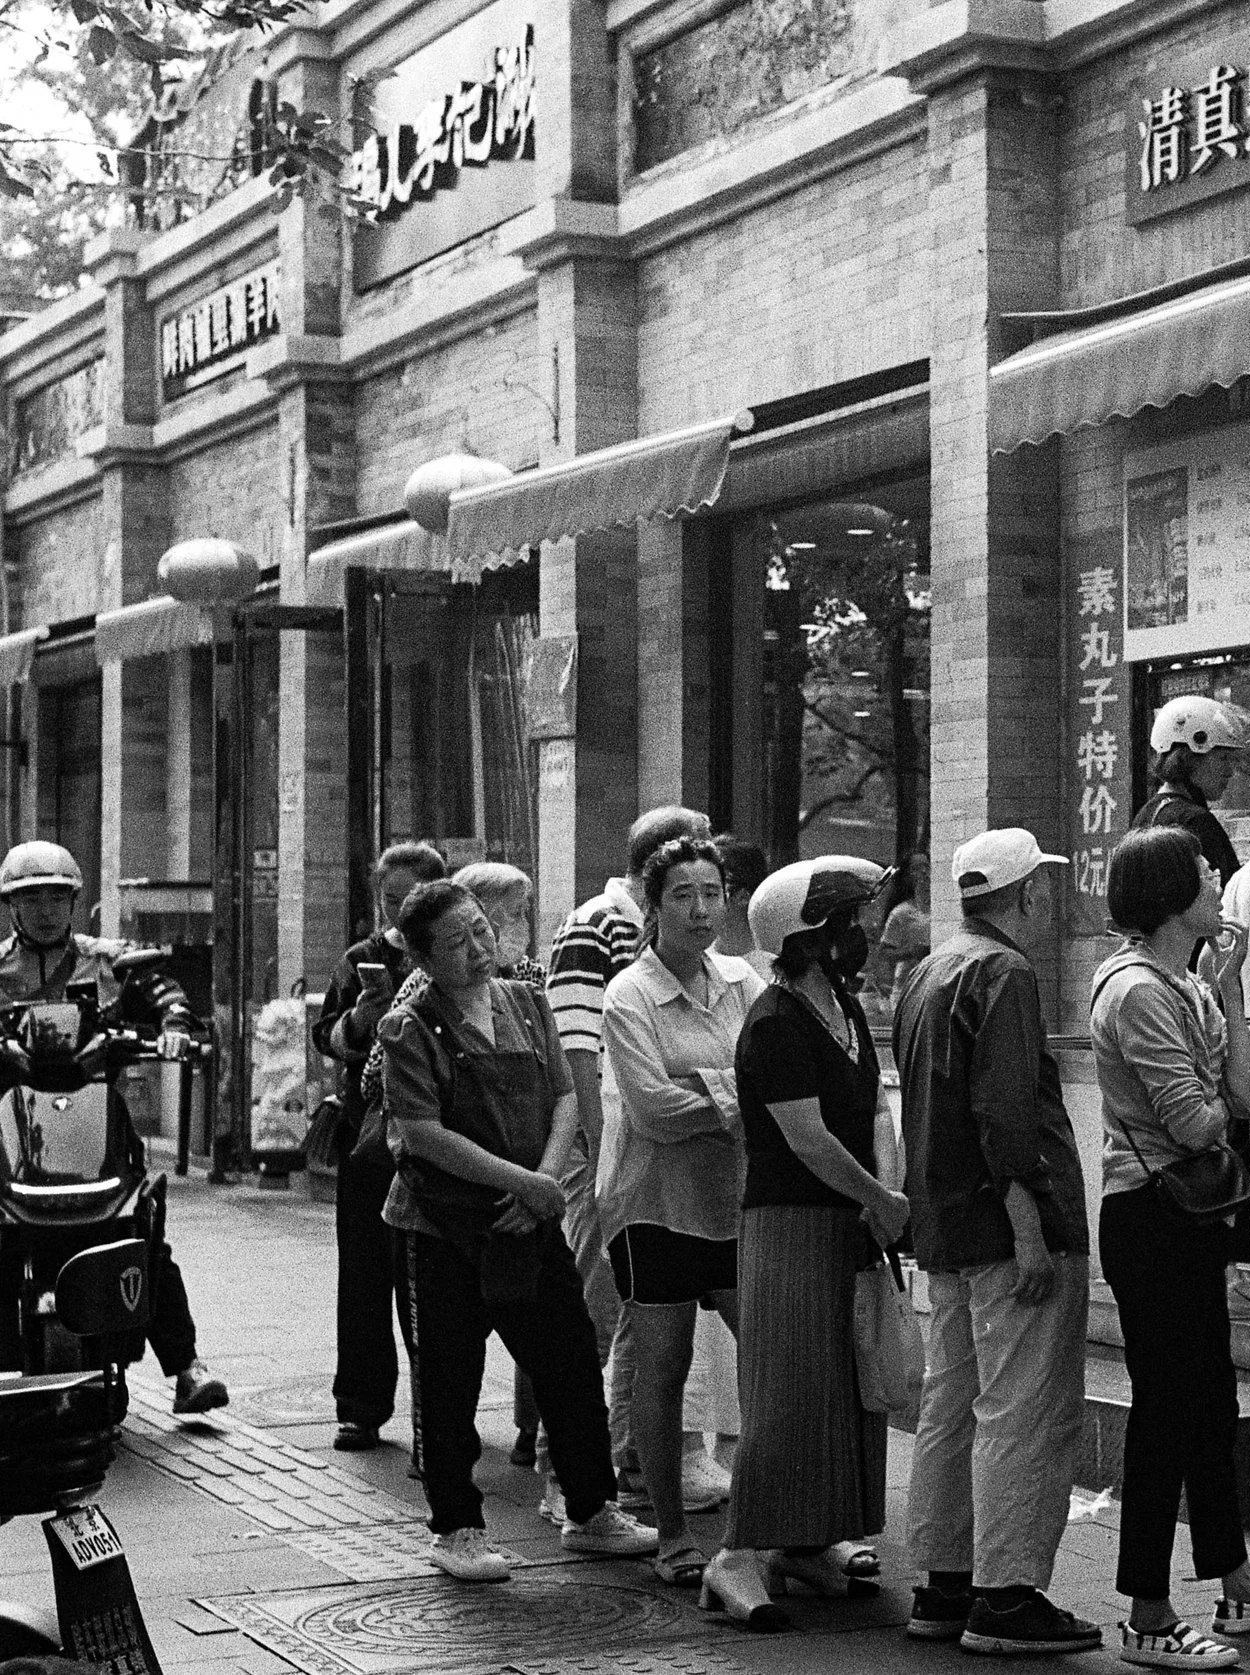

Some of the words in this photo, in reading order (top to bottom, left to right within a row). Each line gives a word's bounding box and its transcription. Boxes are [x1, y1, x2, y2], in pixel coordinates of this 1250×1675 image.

[1077, 566, 1118, 833] 素丸子特价
[72, 1531, 119, 1564] ADV051
